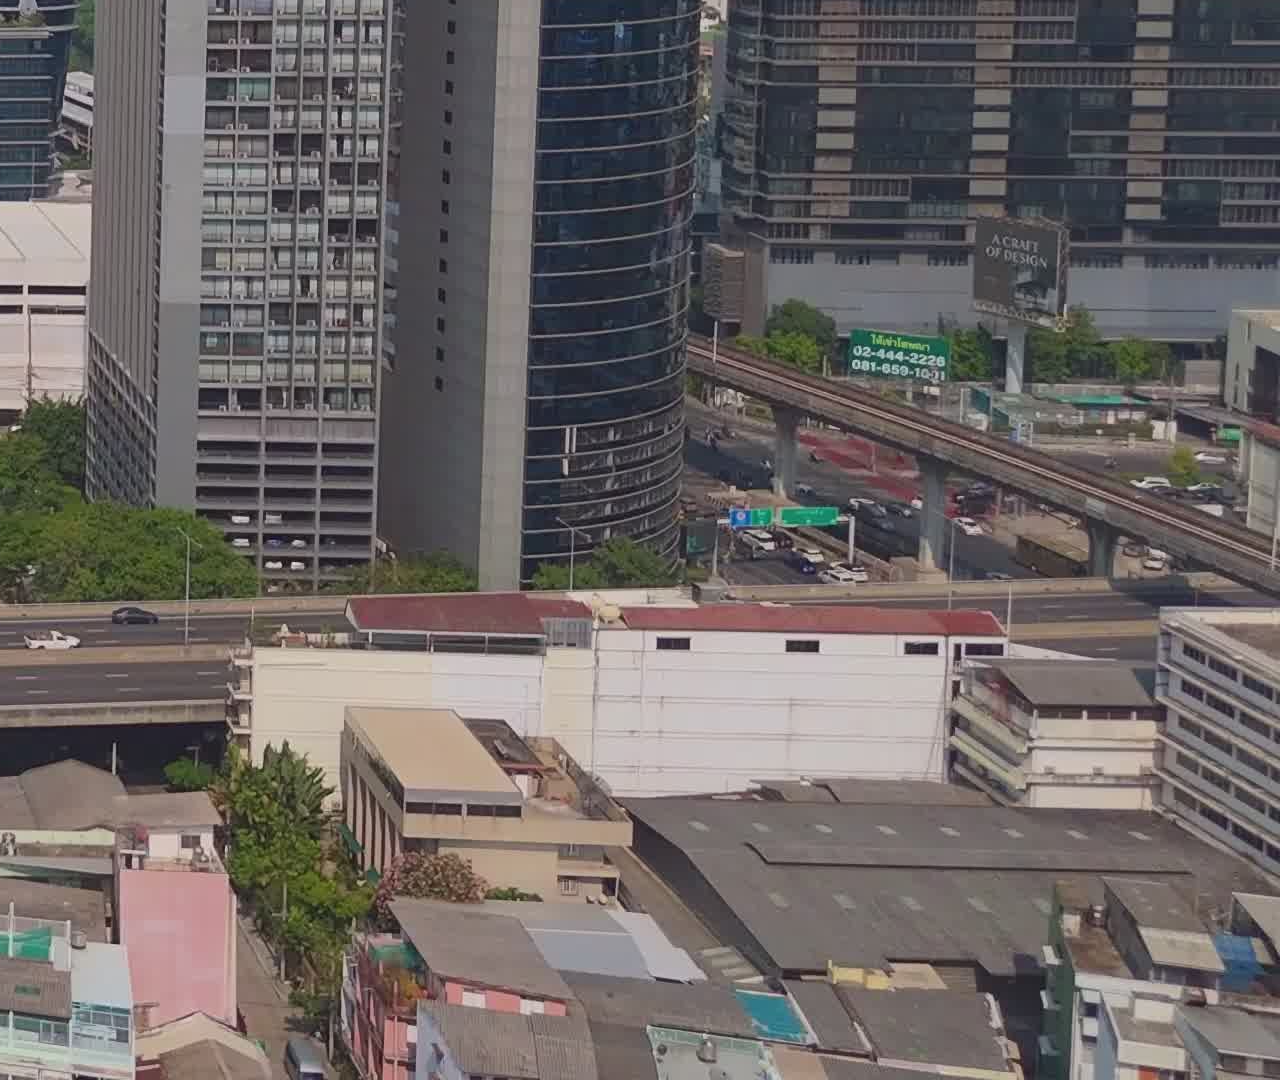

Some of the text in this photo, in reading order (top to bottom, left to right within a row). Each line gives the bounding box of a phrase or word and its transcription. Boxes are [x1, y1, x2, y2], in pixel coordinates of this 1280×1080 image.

[991, 234, 1039, 253] A CRAFT
[985, 246, 1048, 269] OF DESIGN
